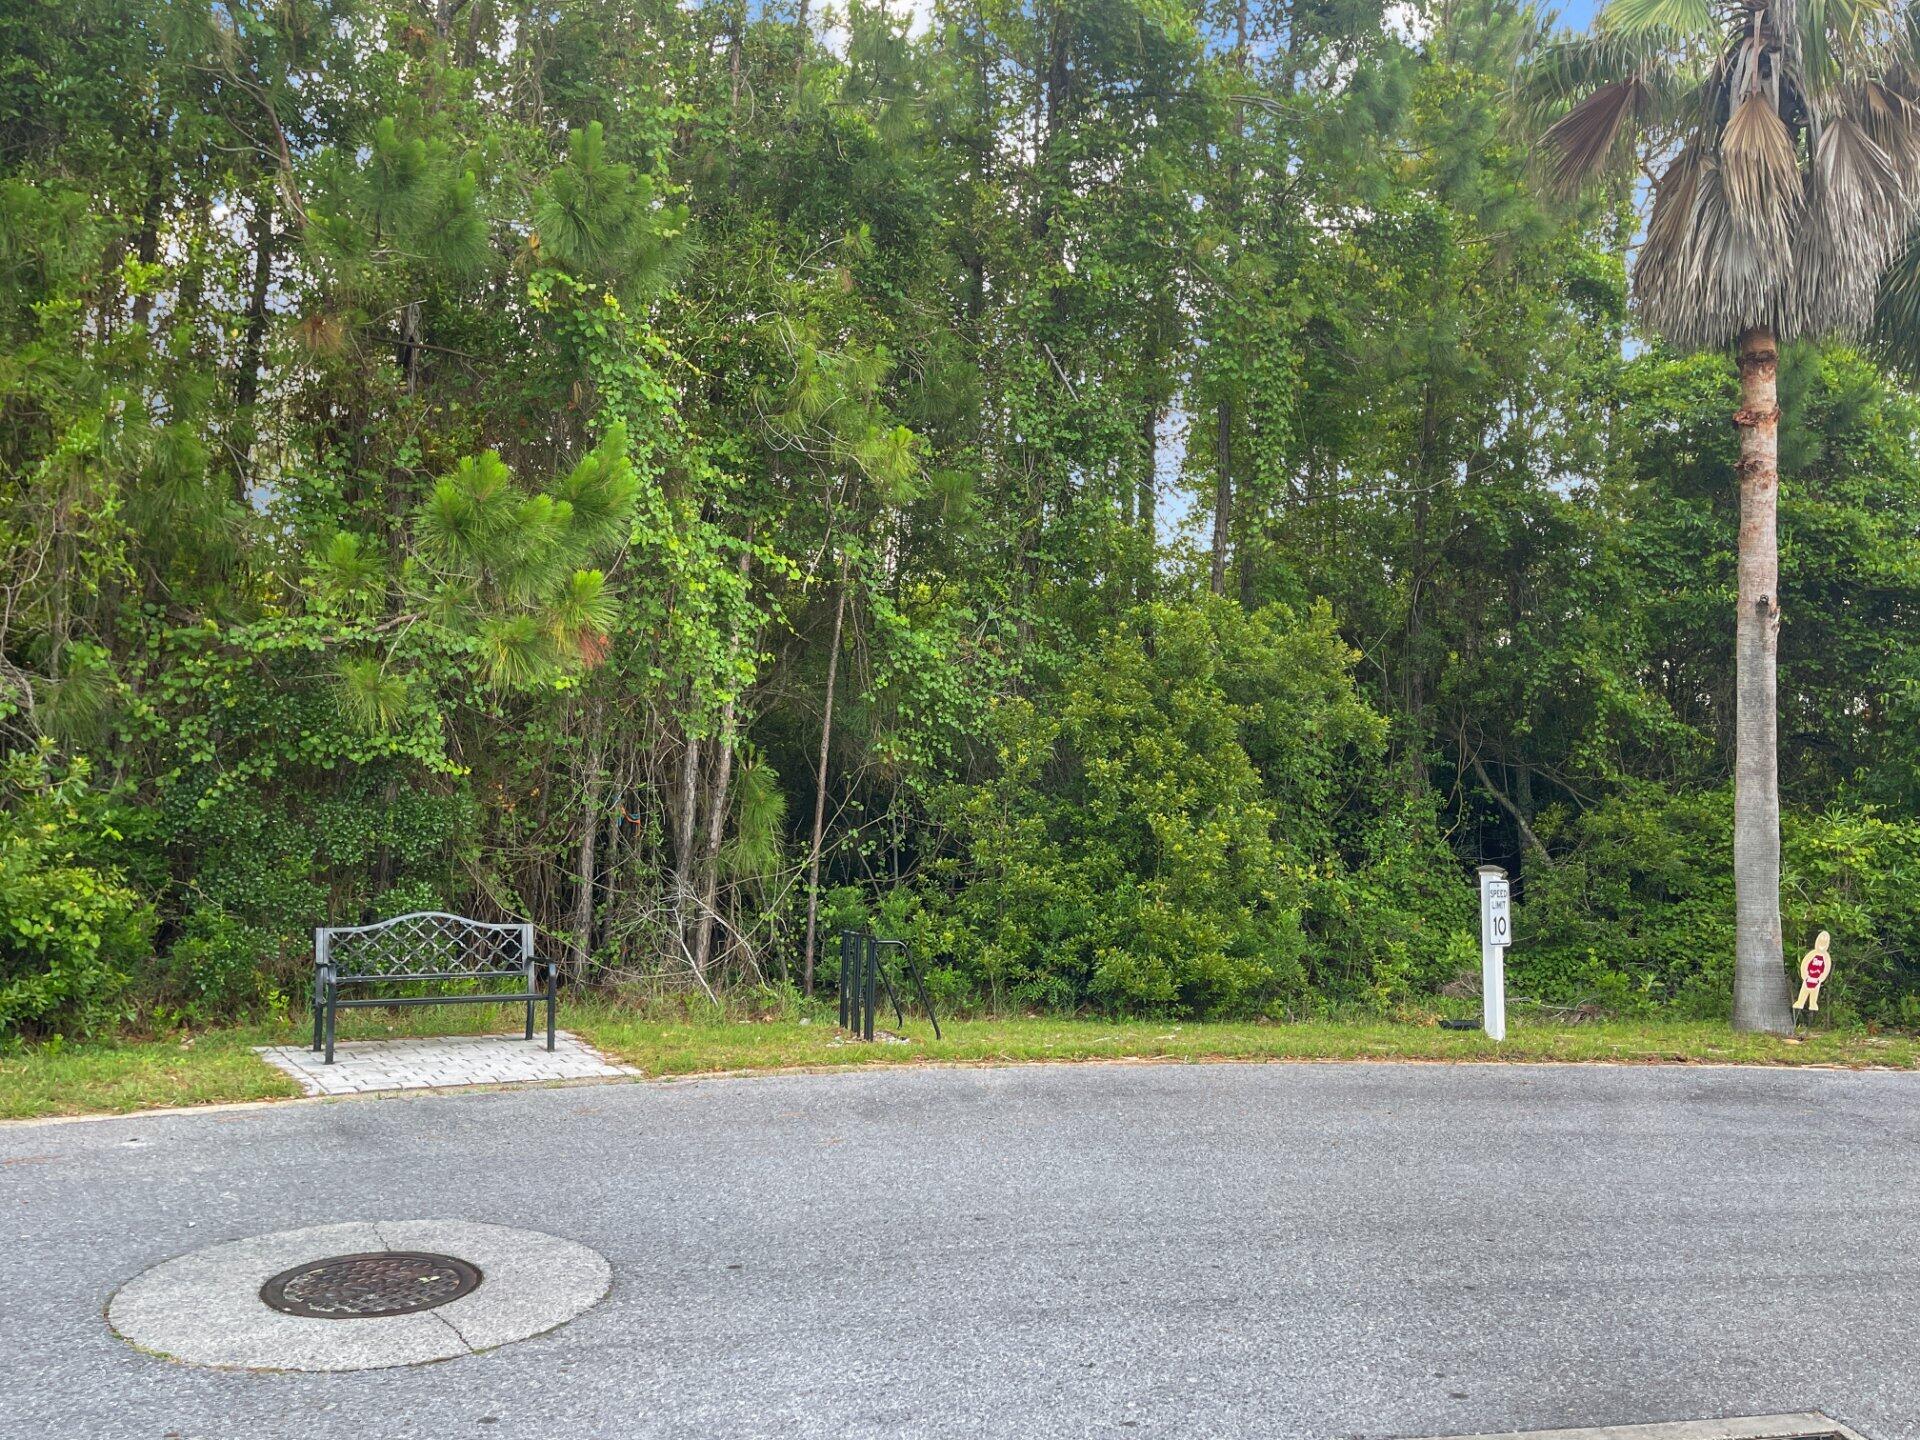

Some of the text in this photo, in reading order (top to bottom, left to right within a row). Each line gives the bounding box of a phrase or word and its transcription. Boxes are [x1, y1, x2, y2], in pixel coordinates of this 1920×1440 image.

[1490, 889, 1507, 898] SPEED
[1491, 901, 1506, 909] LIMIT
[1493, 916, 1506, 936] 10
